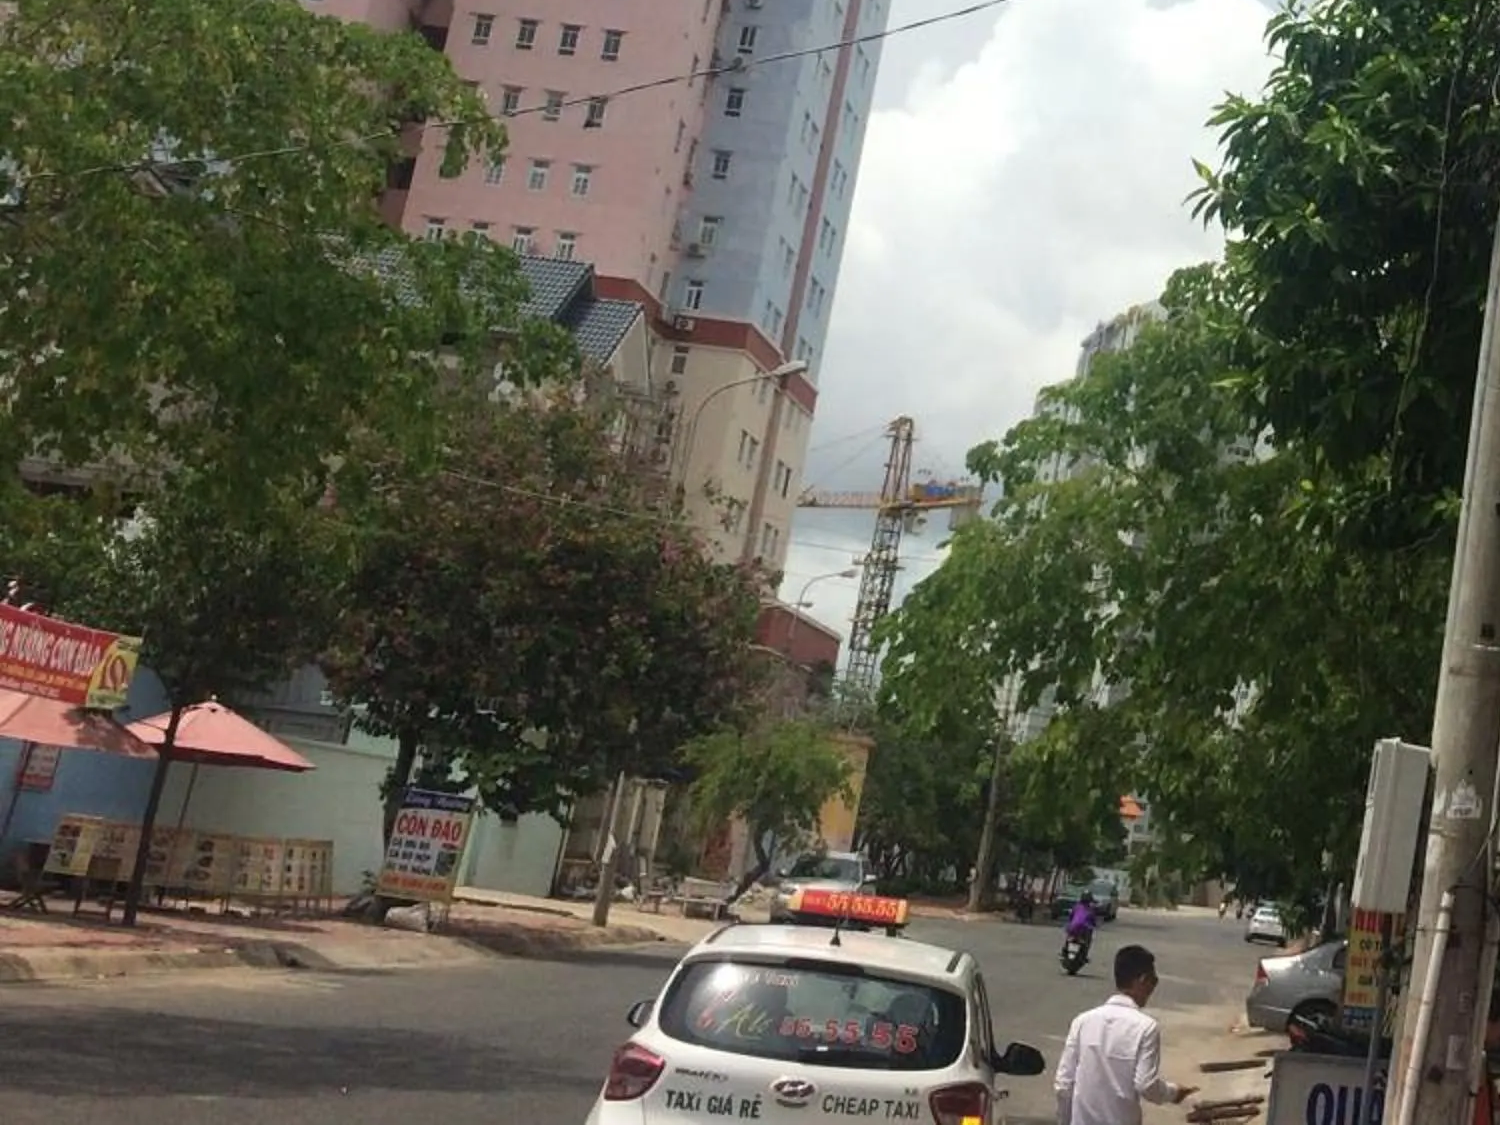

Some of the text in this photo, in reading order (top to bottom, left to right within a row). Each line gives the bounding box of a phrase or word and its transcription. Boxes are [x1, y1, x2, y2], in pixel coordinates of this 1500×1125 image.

[707, 1092, 733, 1116] GIÁ
[739, 1094, 763, 1119] RẺ
[822, 1094, 920, 1120] CHEAP TAXI
